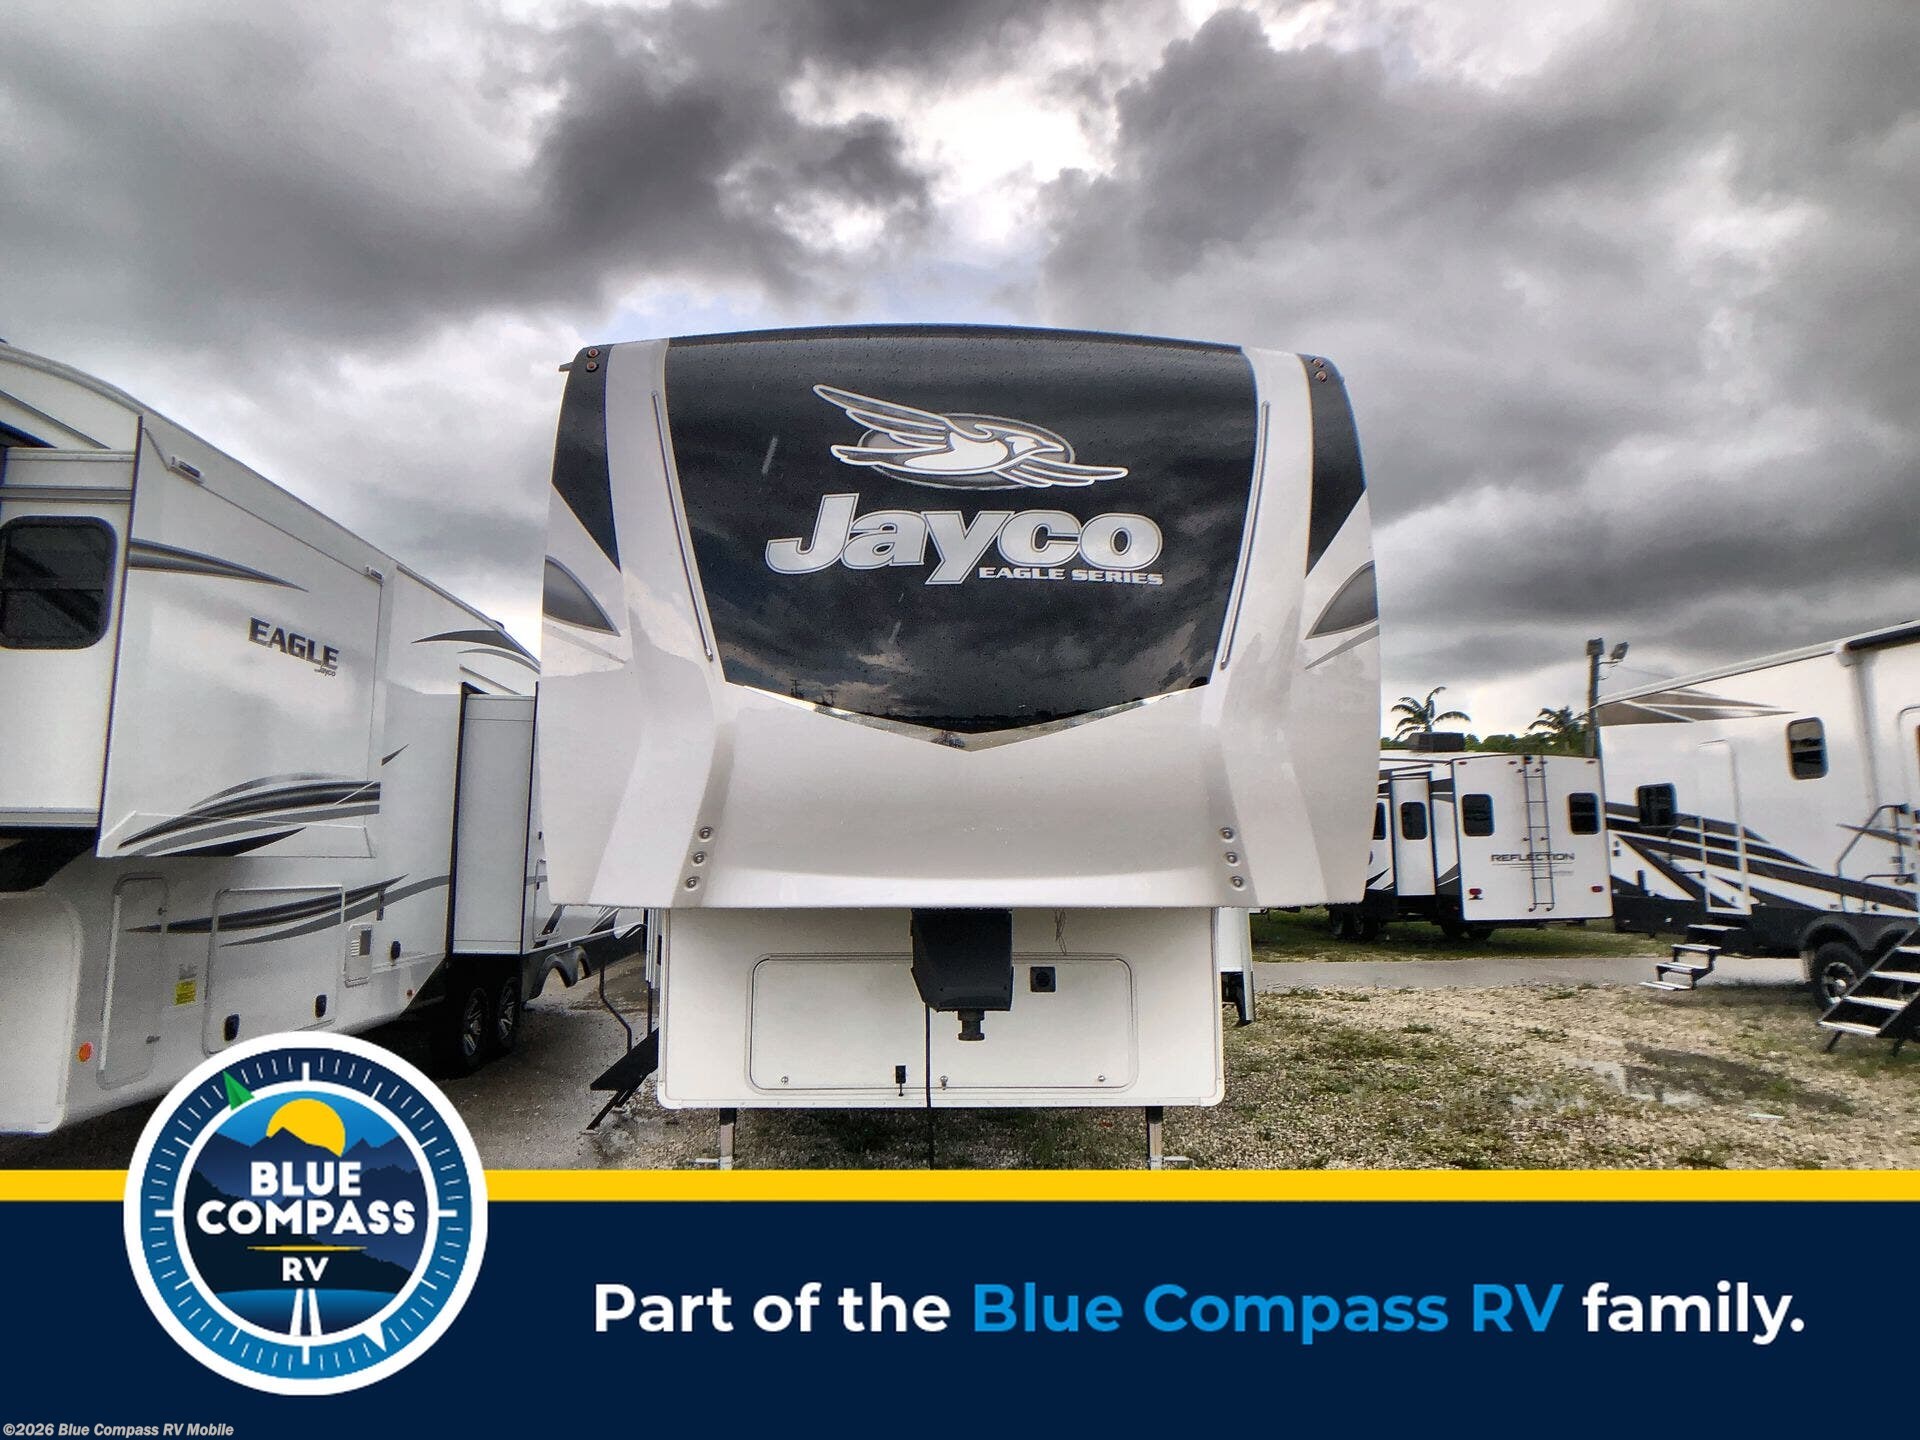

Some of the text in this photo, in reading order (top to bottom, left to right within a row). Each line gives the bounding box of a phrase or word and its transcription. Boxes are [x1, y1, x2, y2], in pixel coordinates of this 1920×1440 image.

[764, 493, 1163, 585] Jayco
[978, 567, 1164, 585] EAGLE SERIES
[248, 616, 340, 670] EAGLE
[1491, 852, 1575, 862] REFLECTION
